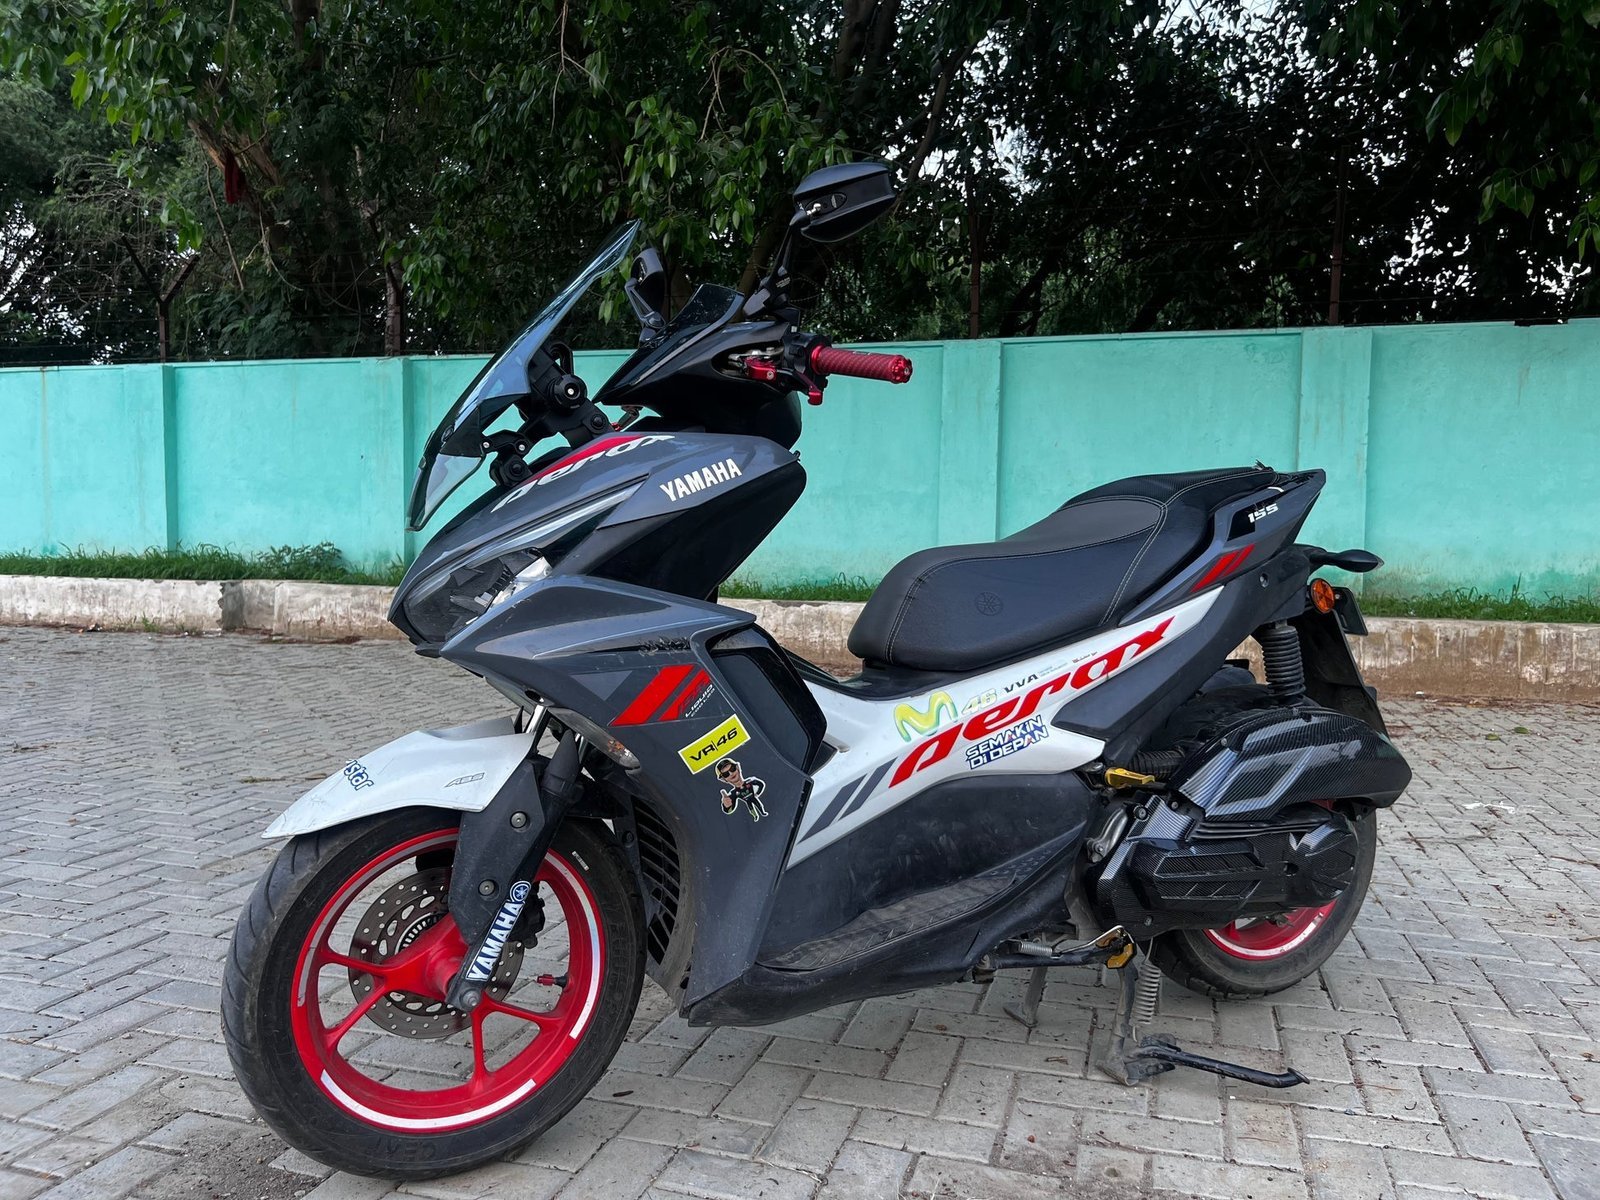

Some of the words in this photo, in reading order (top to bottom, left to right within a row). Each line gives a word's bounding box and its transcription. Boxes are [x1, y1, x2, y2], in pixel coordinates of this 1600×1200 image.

[659, 458, 742, 502] YAMAHA
[1248, 503, 1279, 523] 155
[989, 725, 1049, 760] DEPAN
[466, 900, 525, 981] YAMAHA
